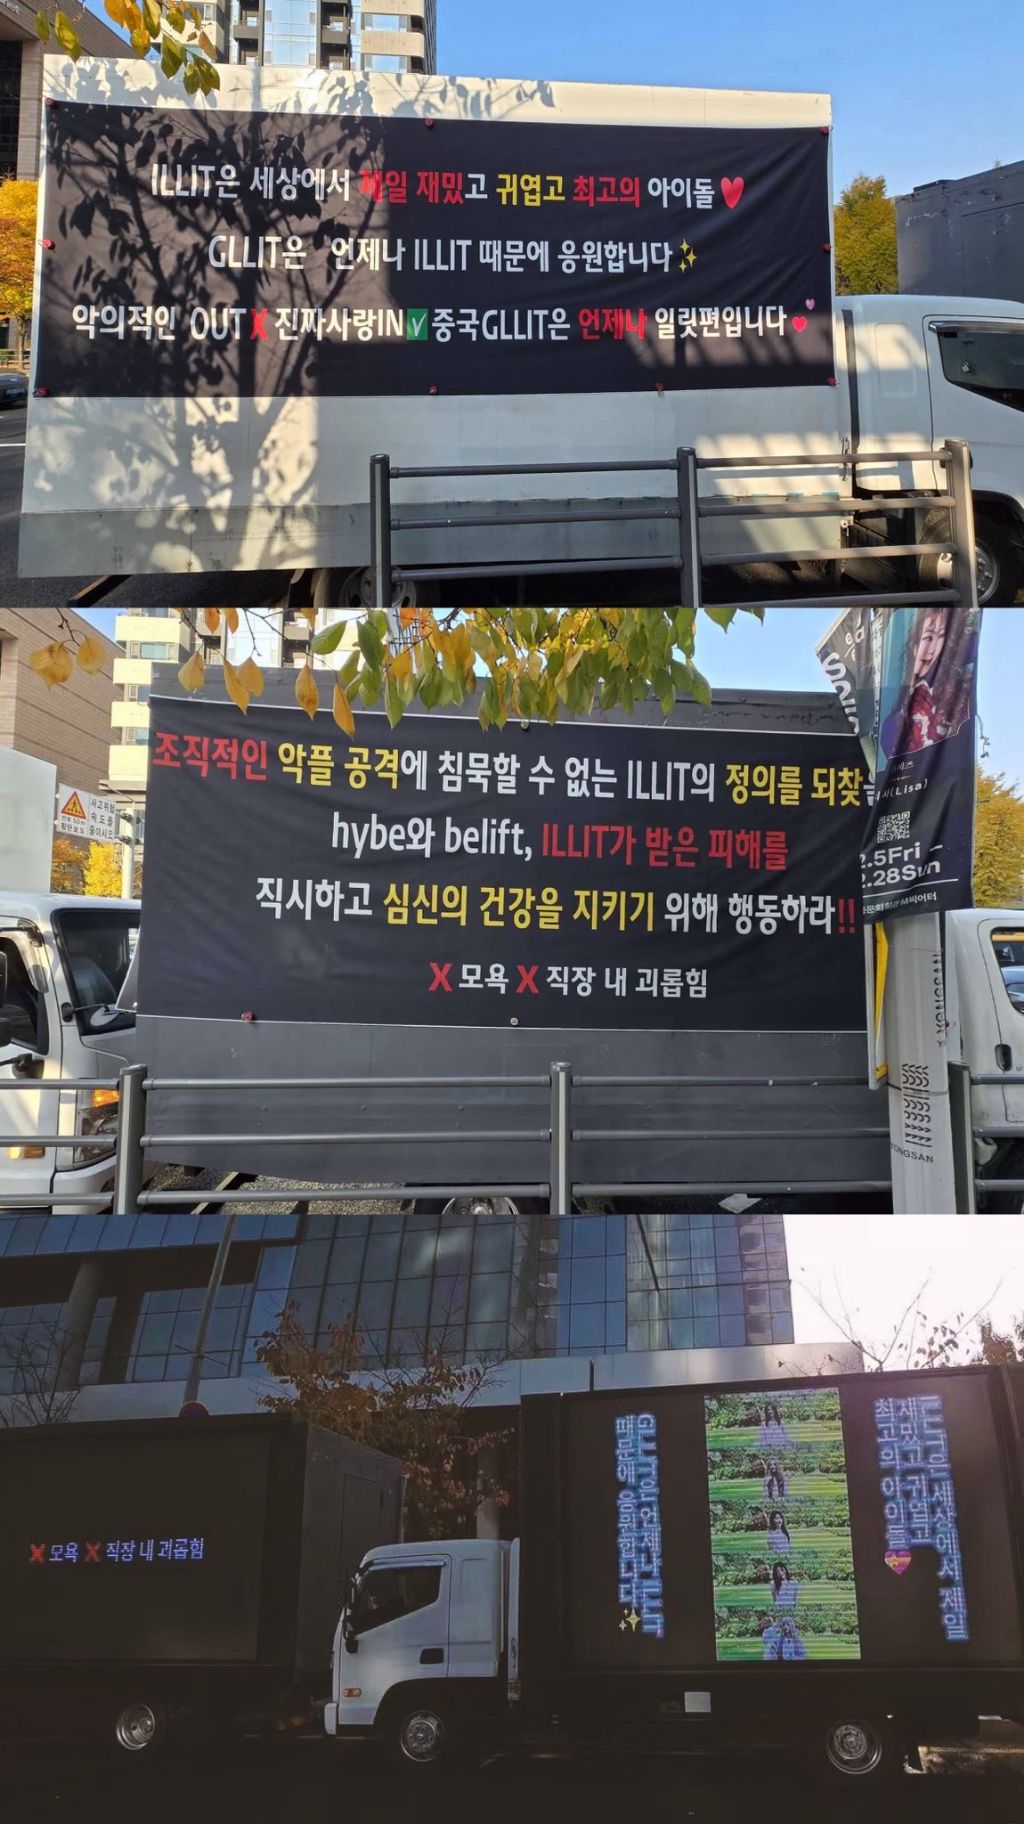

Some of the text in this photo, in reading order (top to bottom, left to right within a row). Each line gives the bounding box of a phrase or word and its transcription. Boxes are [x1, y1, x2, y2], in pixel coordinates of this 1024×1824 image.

[152, 164, 715, 209] ILLIT은 세상에서 제일 재밌고 귀엽고 최고의 아이돌
[208, 235, 673, 274] GLLIT은 언제나 ILLIT 때문에 응원합니다
[72, 304, 787, 342] 악의적인 OUT 진짜사랑IN 중국GLLIT은 언제나 일릿편입니다
[152, 731, 268, 782] 조직적인
[278, 742, 335, 787] 악플
[344, 748, 427, 791] 공격에
[438, 750, 521, 795] 침묵할
[528, 755, 555, 796] 수
[564, 757, 618, 799] 없는
[627, 760, 716, 802] ILLIT의
[725, 763, 803, 806] 정의를
[331, 811, 789, 871] hybe와 belift, ILLIT가 받은 피해를
[256, 876, 373, 922] 직시하고
[383, 883, 468, 927] 심신의
[480, 886, 563, 930] 건강을
[572, 889, 655, 932] 지키기
[664, 892, 718, 933] 위해
[459, 962, 708, 999] 모욕 직장 내 괴롭힘
[891, 1143, 934, 1163] YONGSAN
[49, 1537, 205, 1563] 모욕 직장 내 괴롭힘
